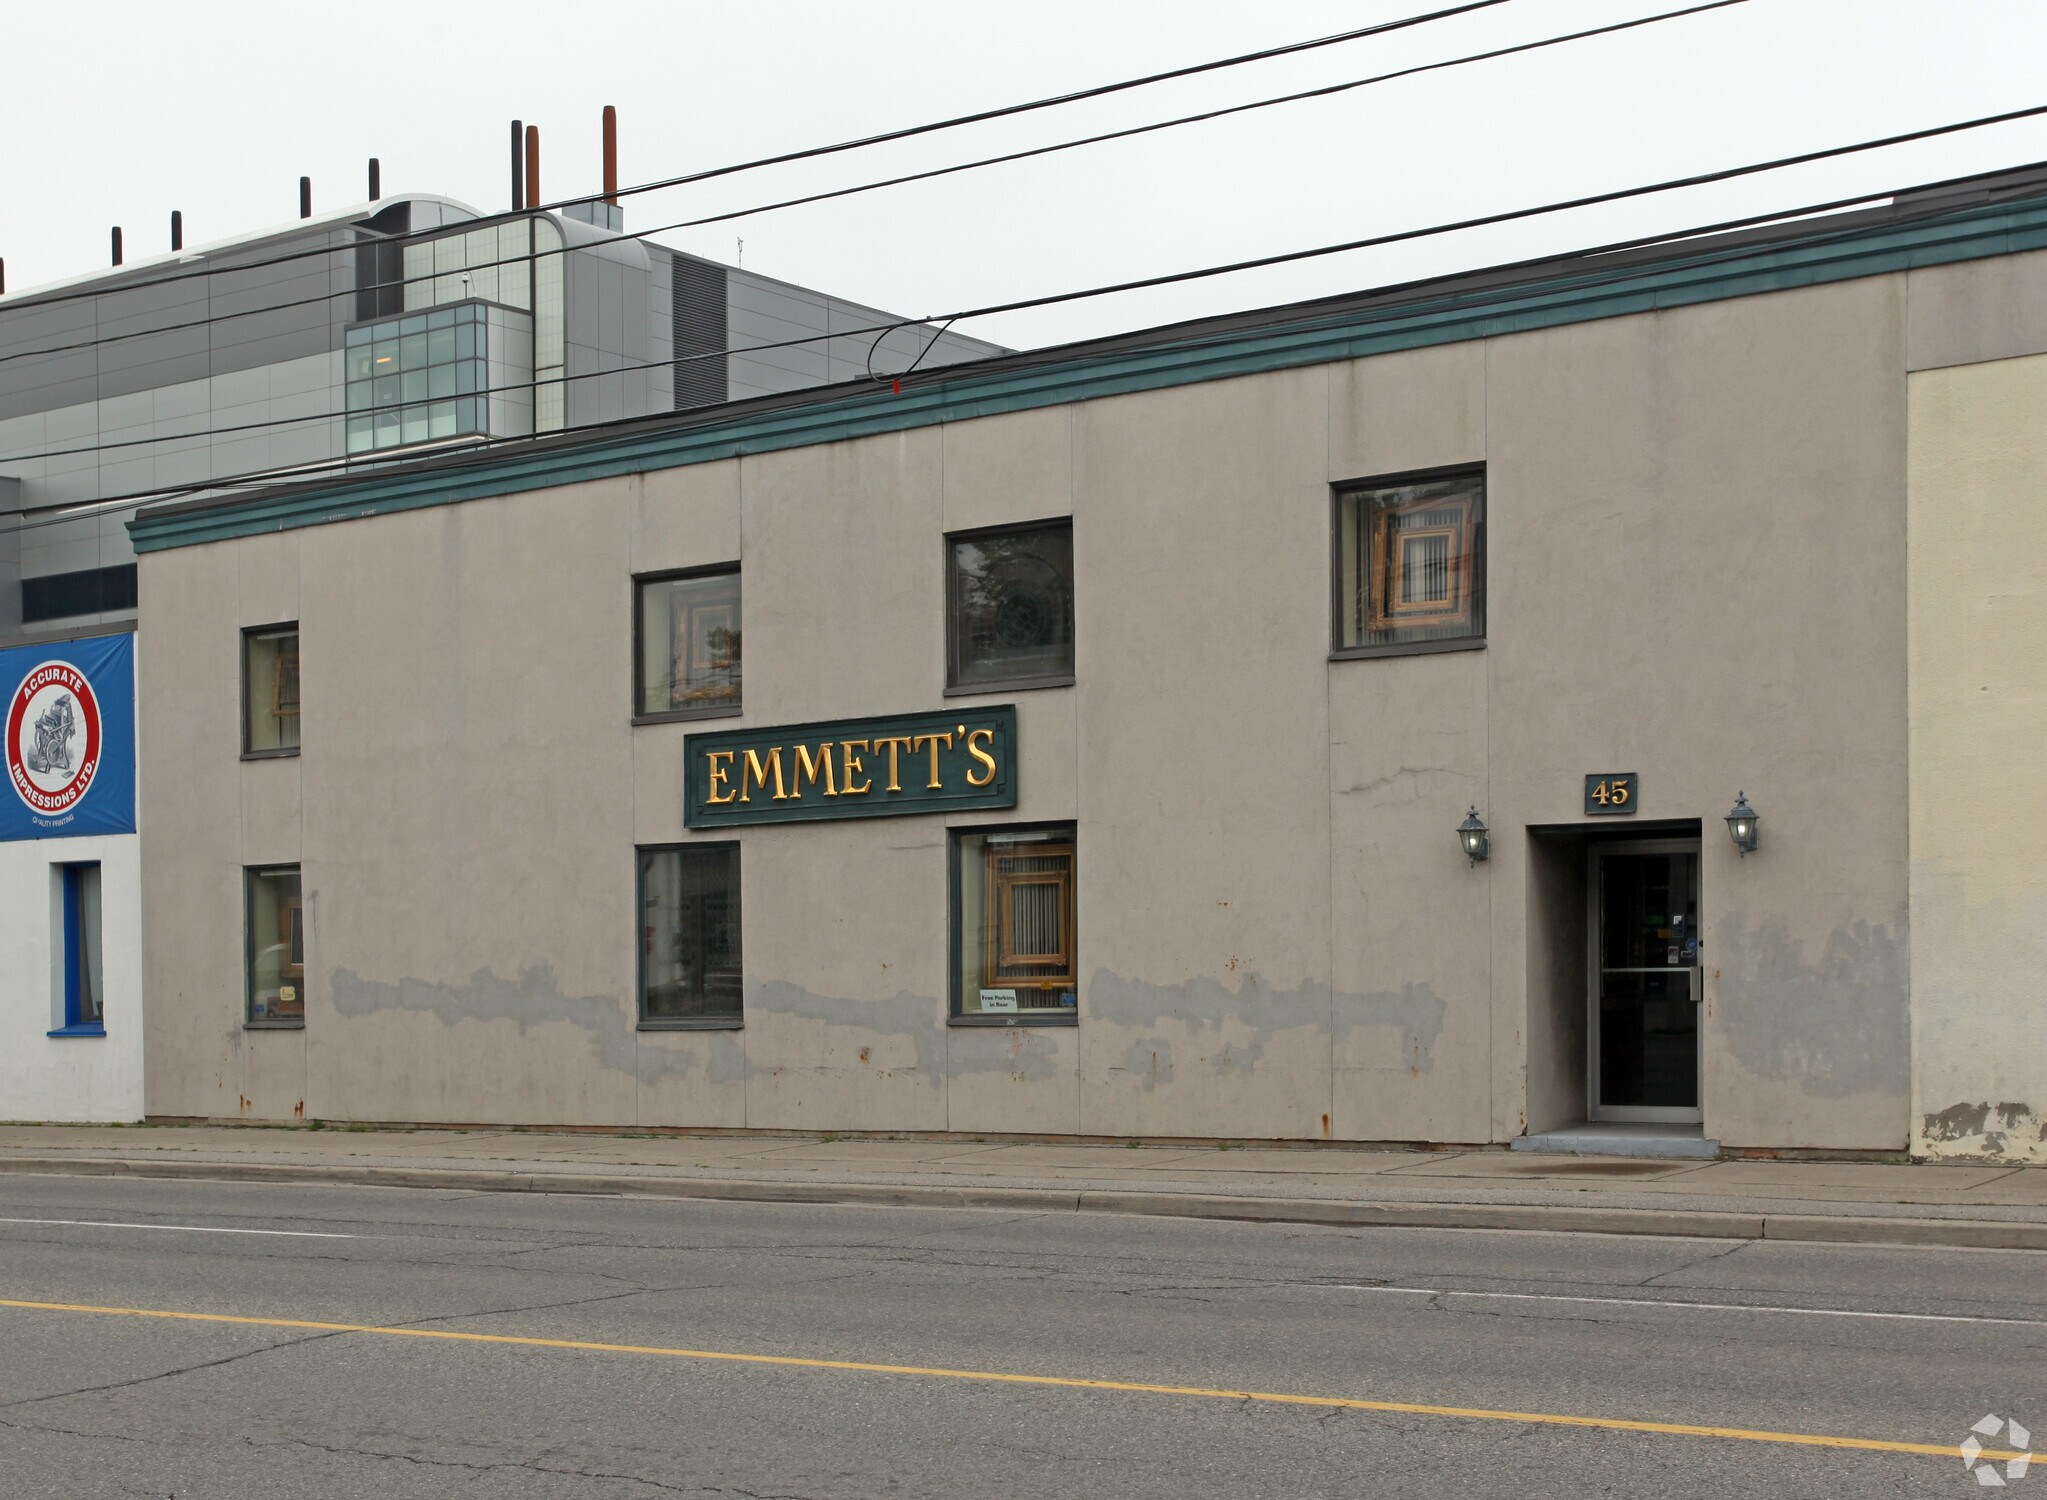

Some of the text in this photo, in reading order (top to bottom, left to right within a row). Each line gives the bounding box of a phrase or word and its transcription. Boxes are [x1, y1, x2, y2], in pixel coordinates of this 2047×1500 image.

[23, 668, 83, 700] ACCURATE
[705, 724, 997, 805] EMMETT'S
[12, 759, 95, 808] IMPRESSIONS LTD.
[1591, 780, 1629, 805] 45
[32, 814, 74, 827] QUALITY PRINTING
